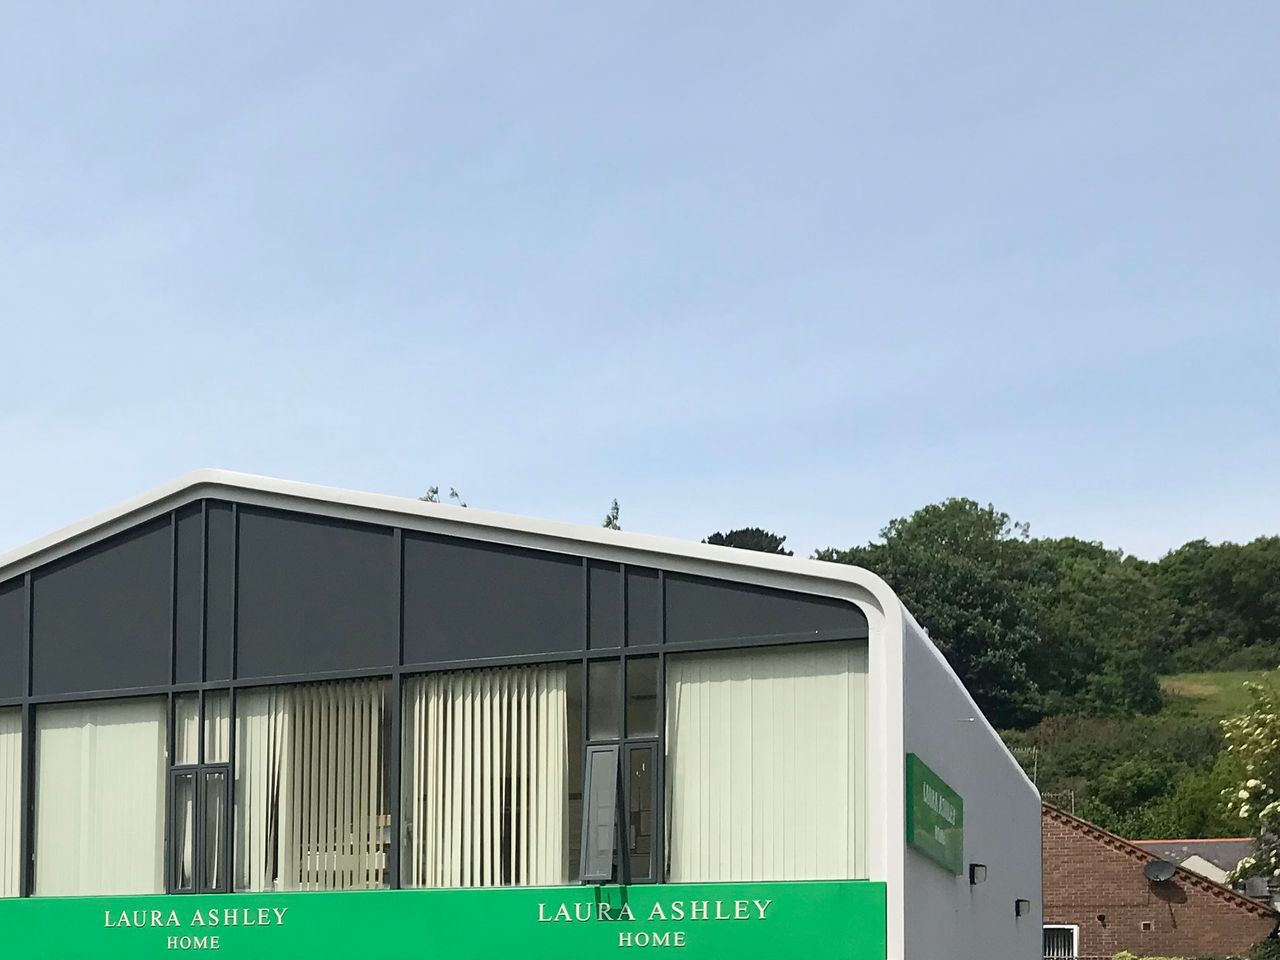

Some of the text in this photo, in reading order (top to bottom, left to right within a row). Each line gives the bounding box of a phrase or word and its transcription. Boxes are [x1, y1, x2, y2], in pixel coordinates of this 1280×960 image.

[104, 907, 288, 928] LAURA ASHLEY
[538, 899, 773, 923] LAURA ASHLEY
[167, 936, 221, 950] HOME
[619, 931, 687, 947] HOME
